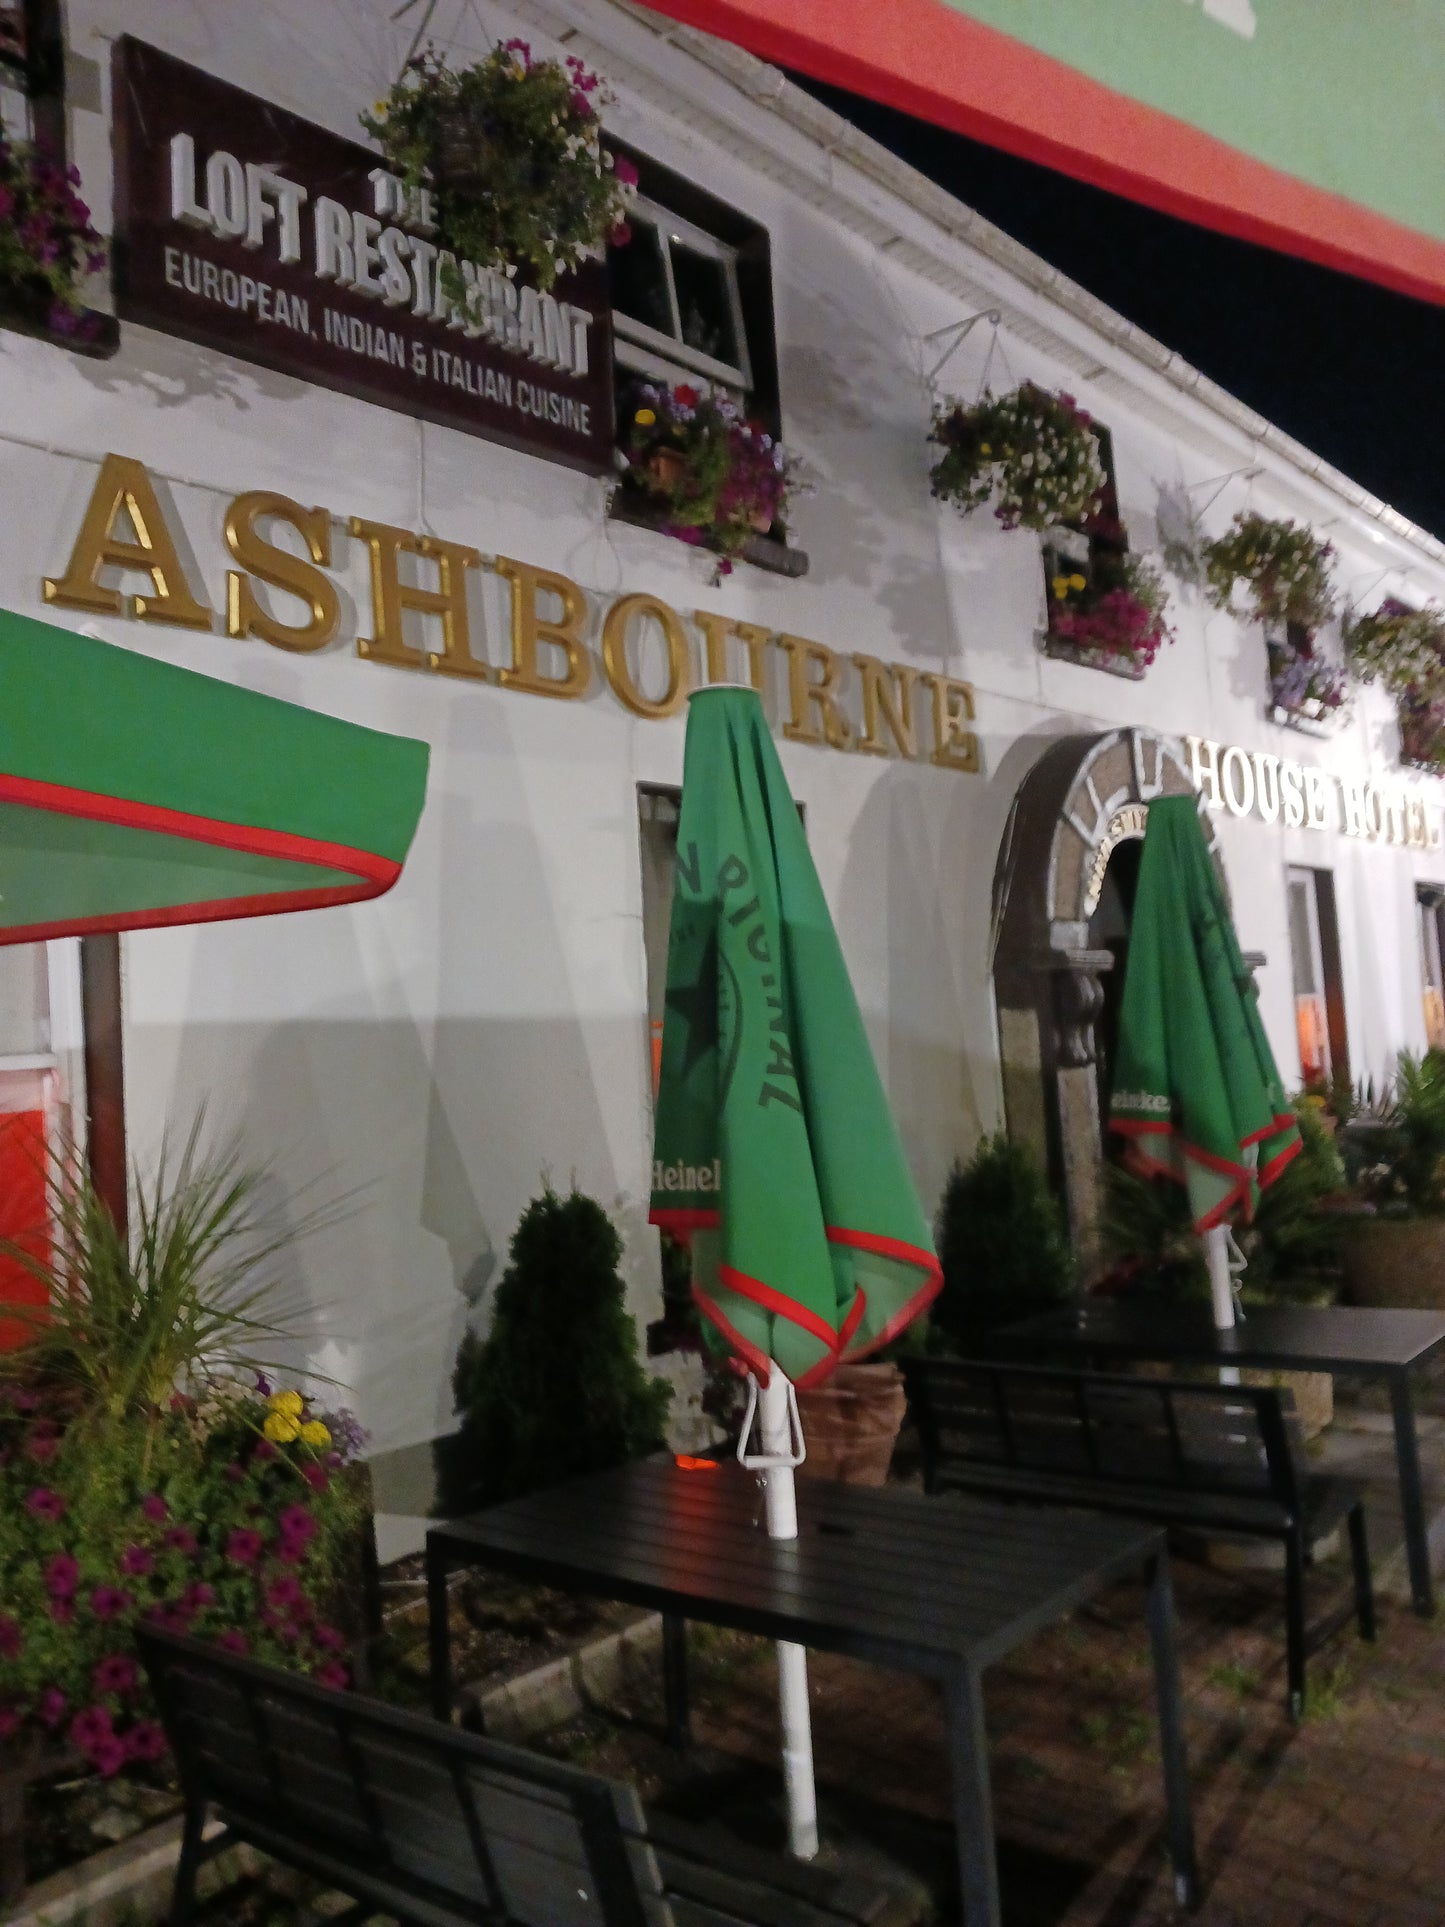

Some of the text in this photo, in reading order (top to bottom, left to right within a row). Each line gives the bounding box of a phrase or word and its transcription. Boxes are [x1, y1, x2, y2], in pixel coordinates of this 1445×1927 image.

[170, 132, 593, 377] LOFT RESTAURANT
[368, 168, 440, 234] THE
[324, 308, 405, 369] INDIAN
[412, 341, 427, 376] &
[433, 349, 512, 407] ITALIAN
[518, 380, 592, 436] CUISINE
[42, 452, 981, 774] ASHBOURNE
[1186, 735, 1441, 849] HOUSE HOTEL
